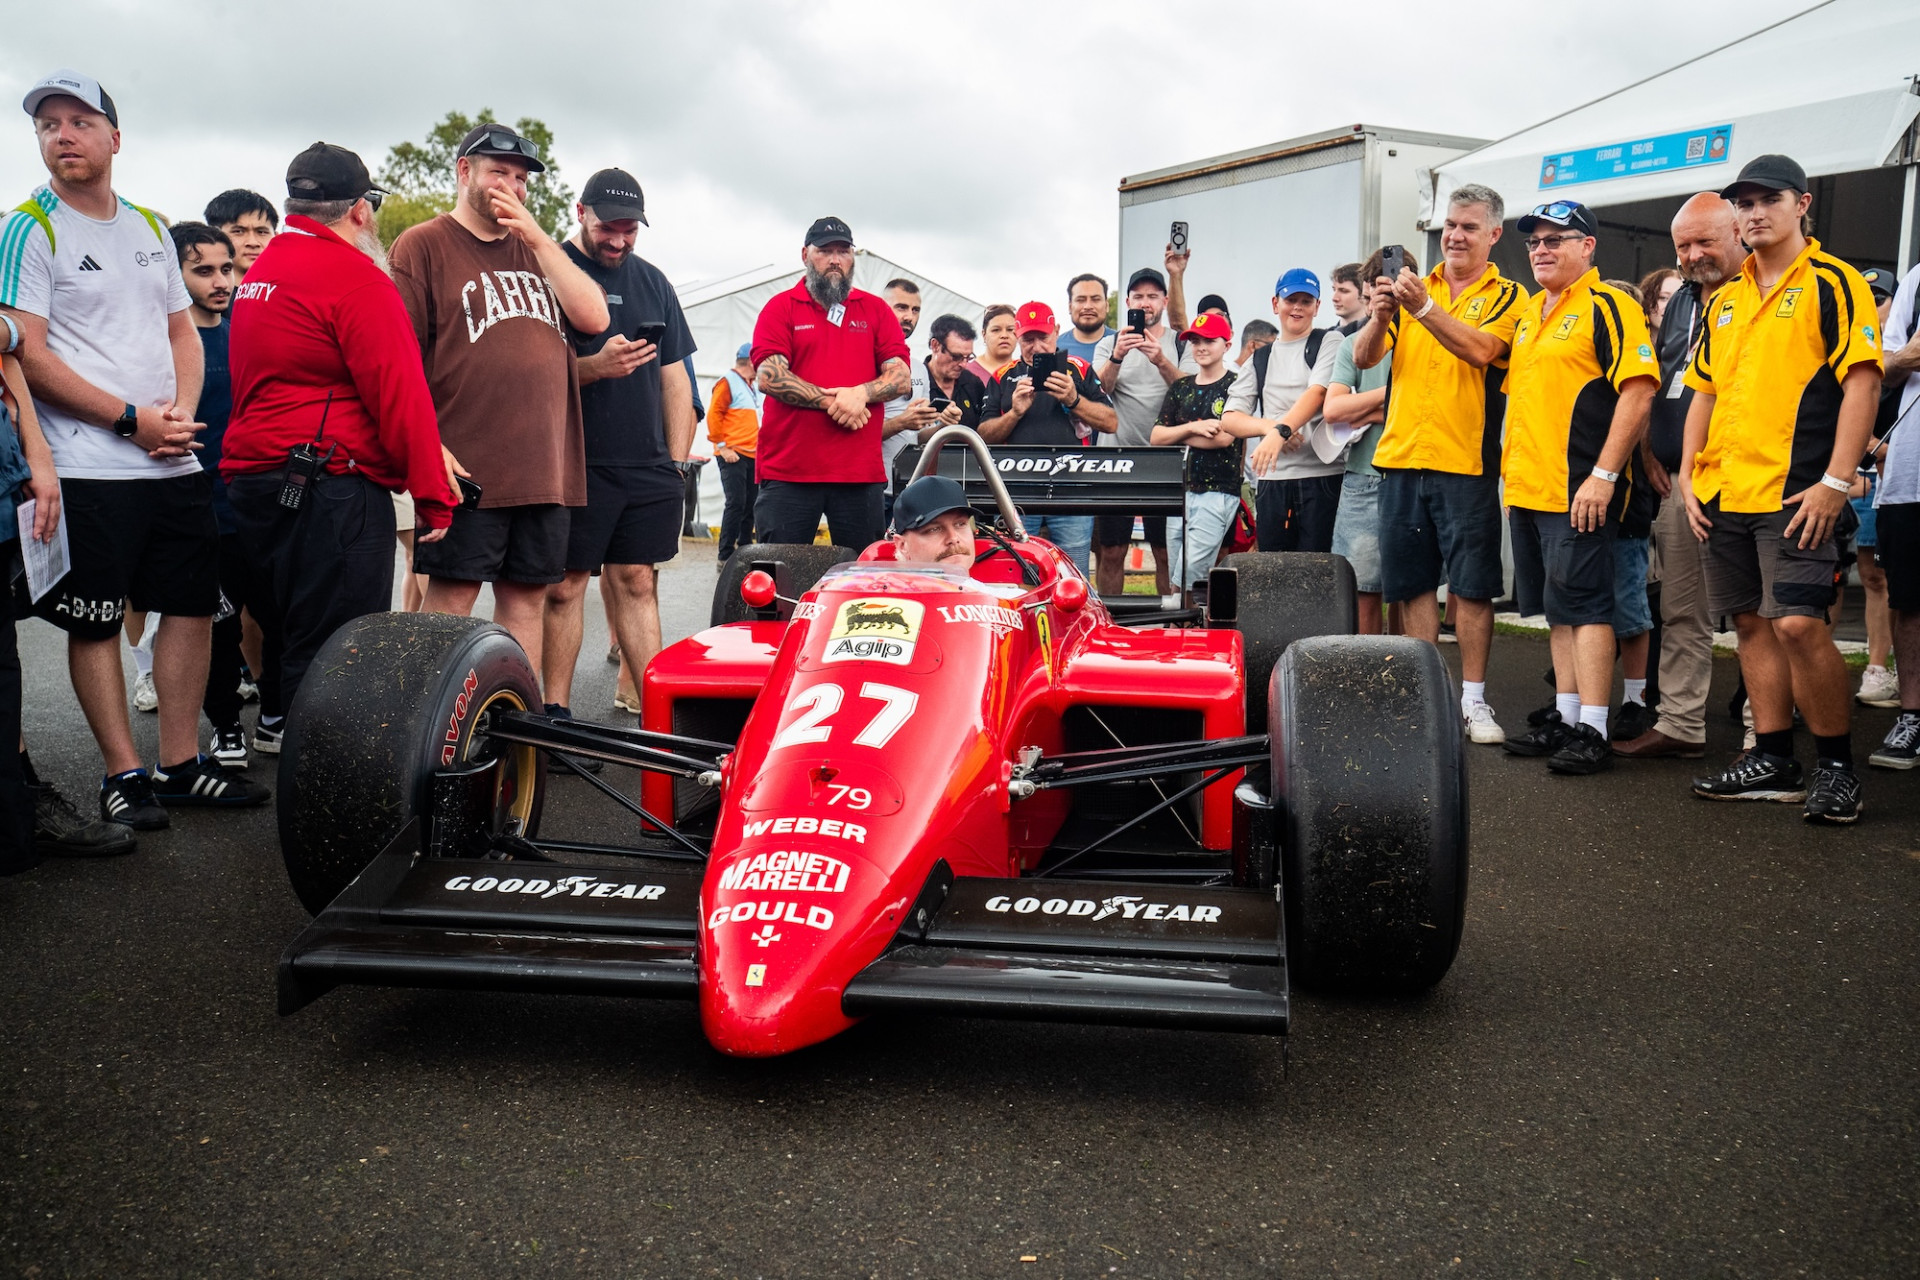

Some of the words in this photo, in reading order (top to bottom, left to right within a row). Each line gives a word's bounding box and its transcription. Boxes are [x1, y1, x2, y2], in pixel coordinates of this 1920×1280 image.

[1595, 147, 1622, 162] FERRARI
[830, 306, 843, 323] 17
[979, 454, 1134, 475] OODYEAR
[937, 604, 1024, 631] LONGINES
[831, 638, 903, 659] Agip
[441, 668, 479, 766] AVON
[773, 682, 920, 750] 27
[827, 784, 872, 810] 79
[742, 817, 868, 844] WEBER
[721, 851, 851, 882] MAGNETI
[718, 868, 850, 893] MARELLI
[708, 901, 834, 930] GOULD
